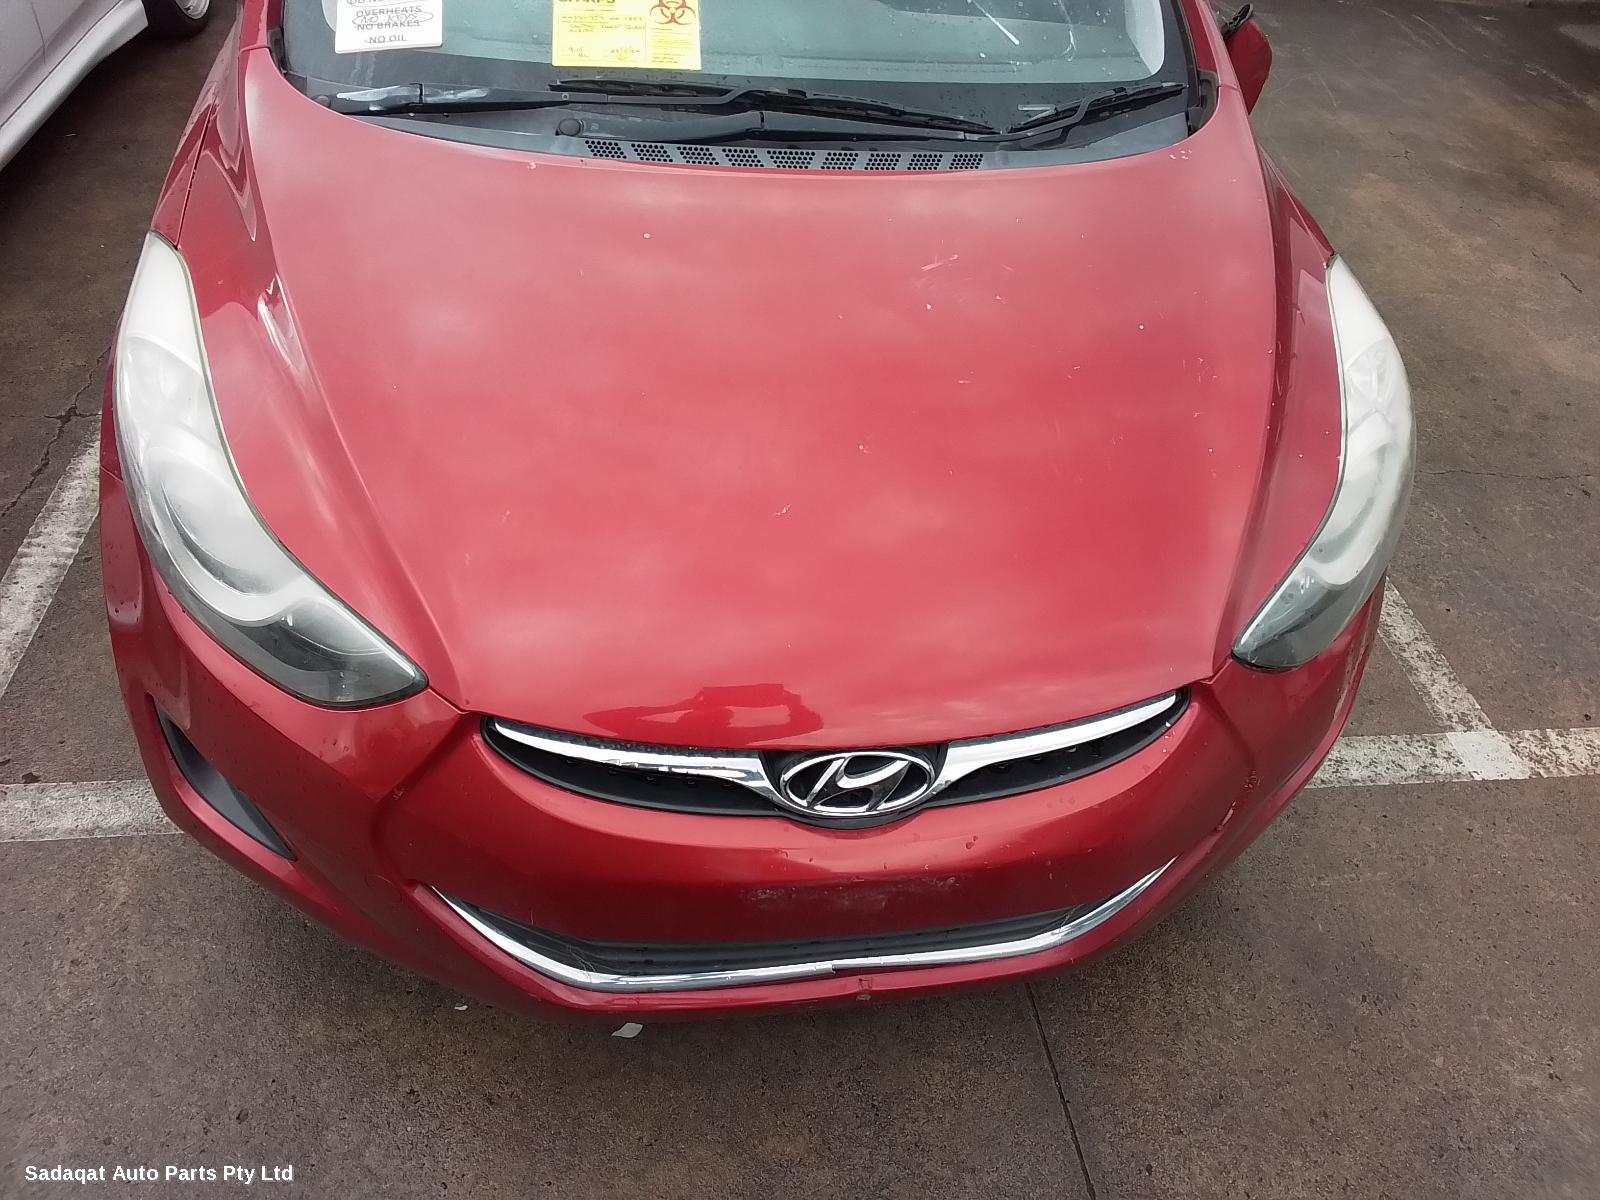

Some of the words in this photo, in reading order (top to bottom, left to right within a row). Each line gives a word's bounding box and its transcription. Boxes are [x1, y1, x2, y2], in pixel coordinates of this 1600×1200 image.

[356, 6, 422, 17] OVERHEATS
[357, 23, 374, 31] NO
[377, 19, 420, 29] BRAKES
[369, 35, 386, 44] NO
[389, 34, 407, 42] OIL
